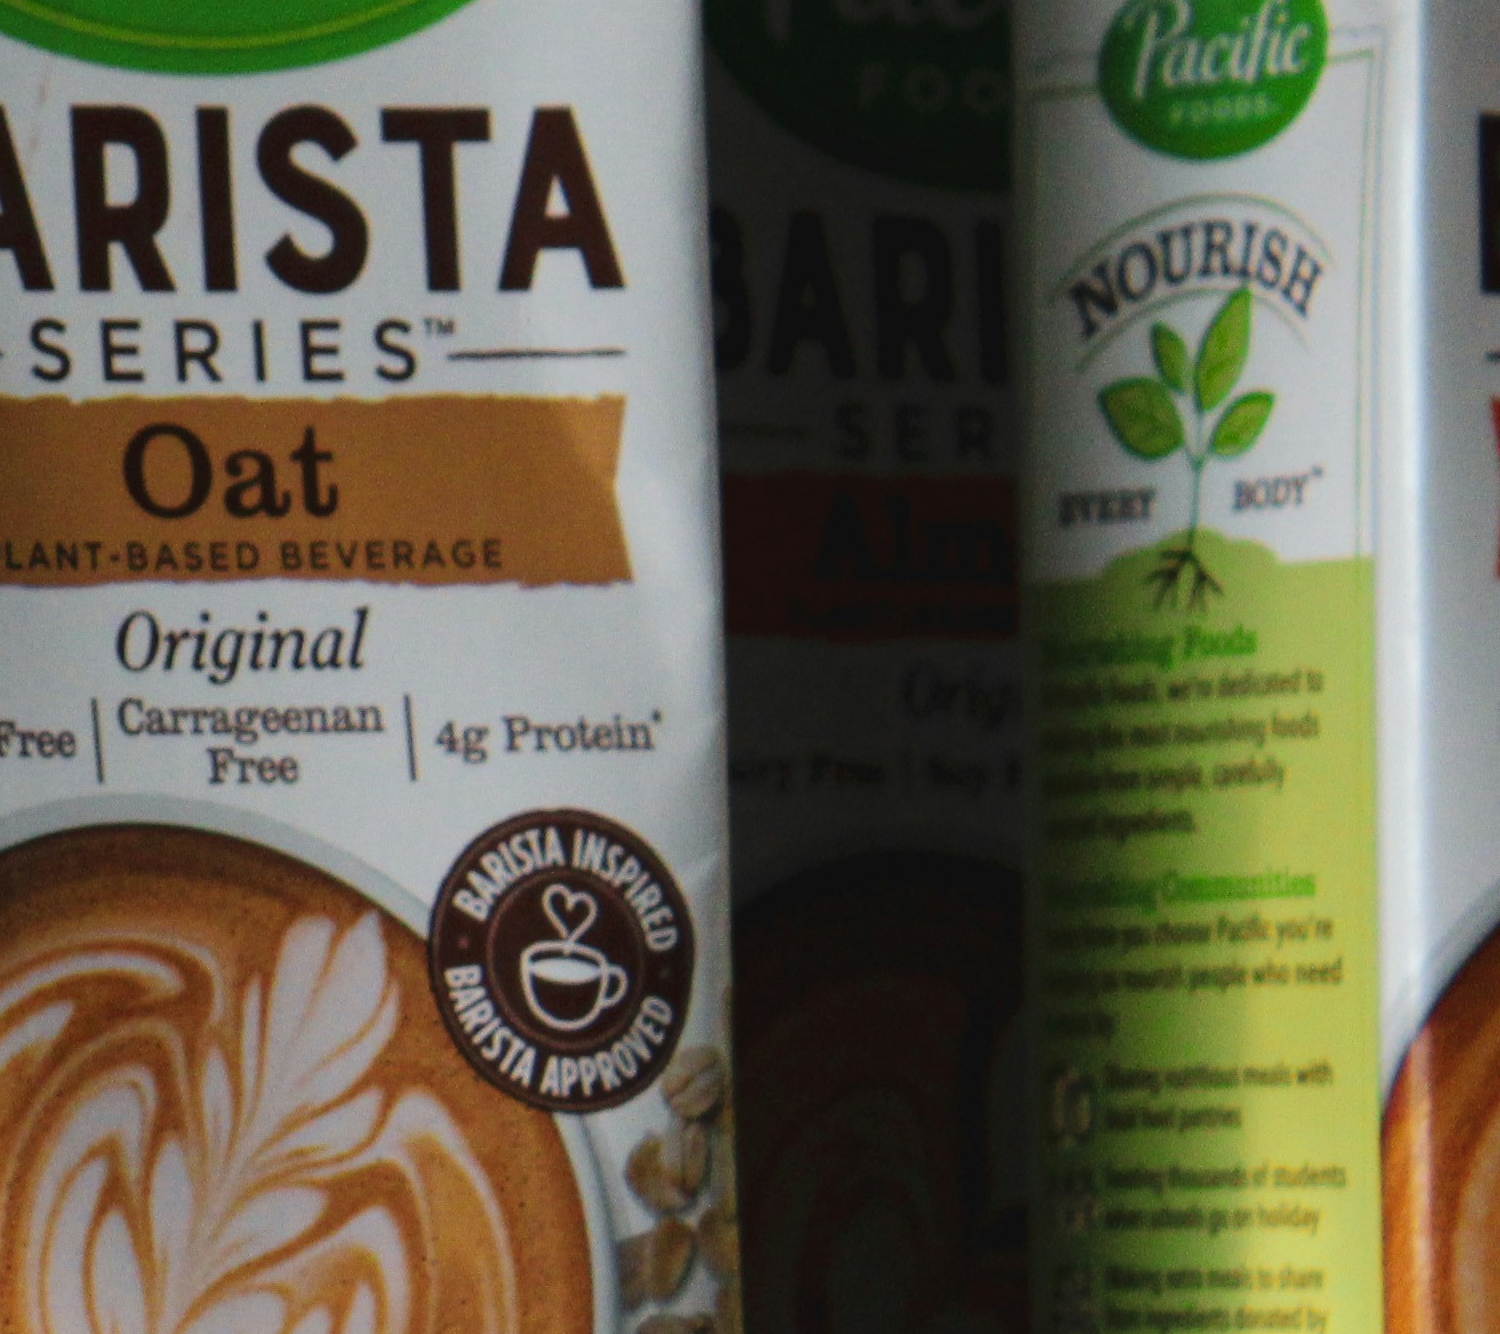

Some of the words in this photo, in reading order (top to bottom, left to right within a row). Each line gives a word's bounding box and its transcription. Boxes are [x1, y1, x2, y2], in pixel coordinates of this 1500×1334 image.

[858, 65, 1009, 114] FOO
[1068, 218, 1324, 342] NOURISH
[834, 404, 996, 462] SER
[122, 421, 340, 522] Oat
[279, 536, 504, 572] BEVERAGE
[812, 491, 1011, 584] Alm
[115, 608, 370, 683] Original
[116, 696, 385, 745] Carrageenan
[435, 719, 490, 761] 4g
[207, 747, 300, 786] Free
[452, 826, 567, 921] BARISTA
[572, 829, 679, 952] INSPIRED
[444, 964, 537, 1089] BARISTA
[540, 996, 673, 1097] APPROVED
